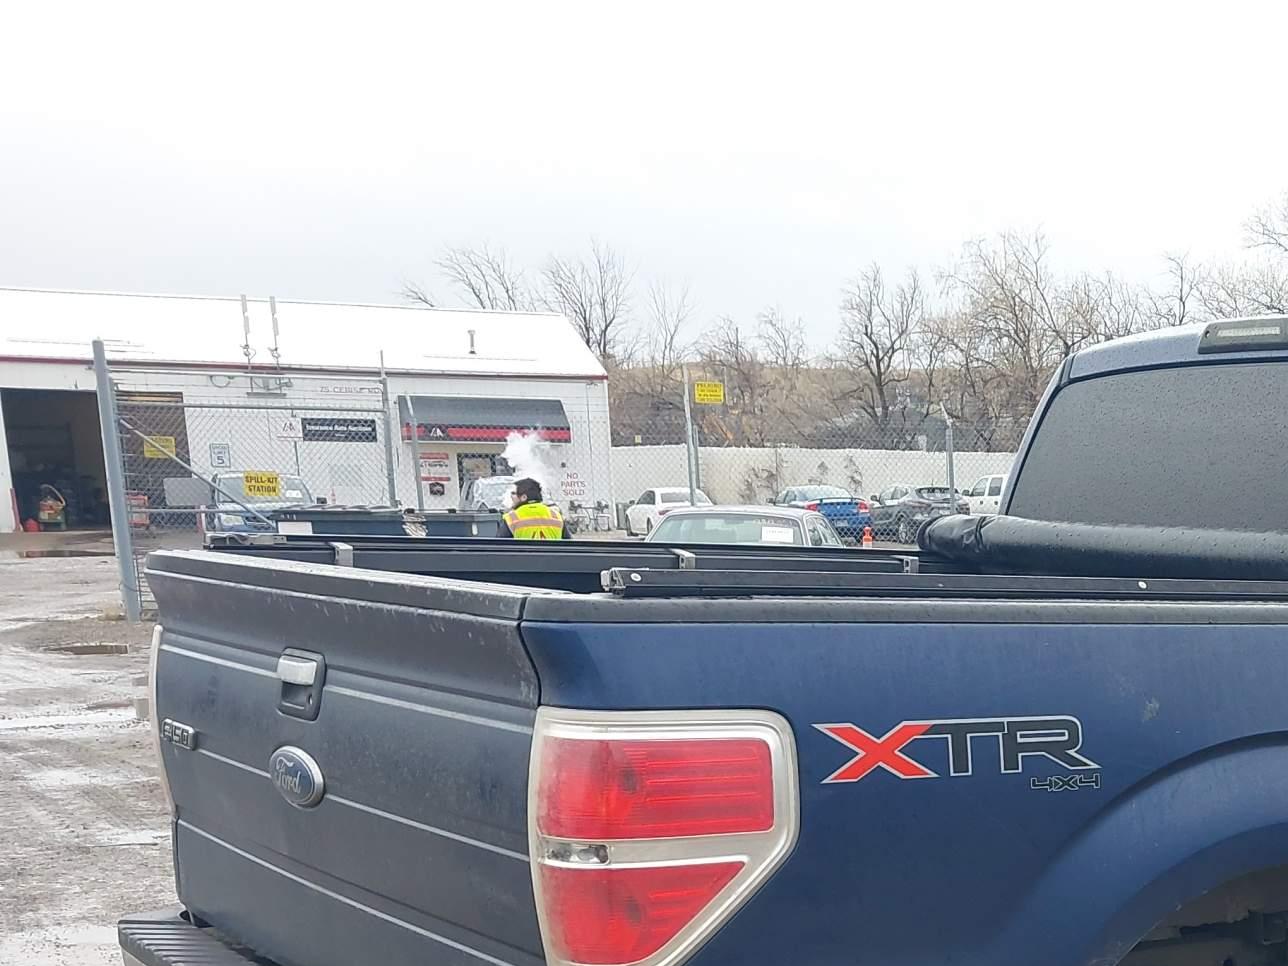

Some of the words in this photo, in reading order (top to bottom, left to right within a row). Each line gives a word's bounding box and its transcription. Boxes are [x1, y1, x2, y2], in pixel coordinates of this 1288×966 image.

[216, 455, 225, 465] 5
[245, 475, 278, 484] SPILL-KIT
[561, 480, 586, 488] PARTS
[247, 484, 277, 493] STATION
[811, 715, 1101, 784] XTR
